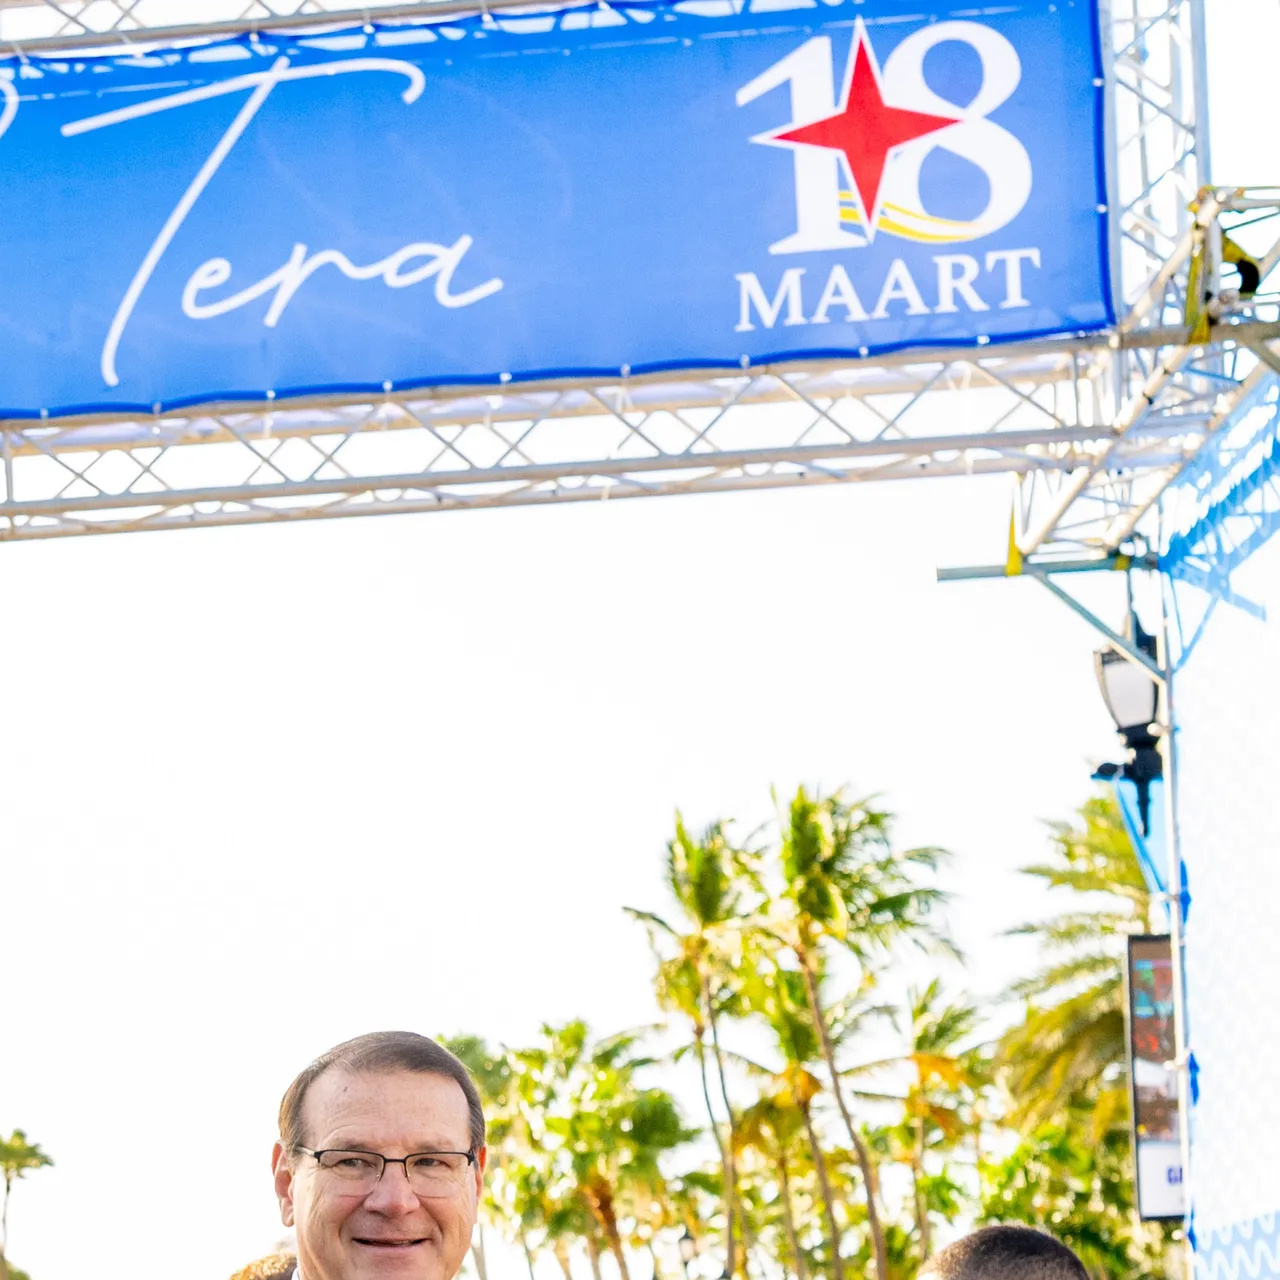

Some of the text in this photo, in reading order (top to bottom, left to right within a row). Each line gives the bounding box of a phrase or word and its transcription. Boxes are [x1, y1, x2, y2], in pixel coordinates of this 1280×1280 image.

[61, 55, 503, 387] Tera
[736, 20, 1032, 255] 18
[735, 247, 1041, 332] MAART
